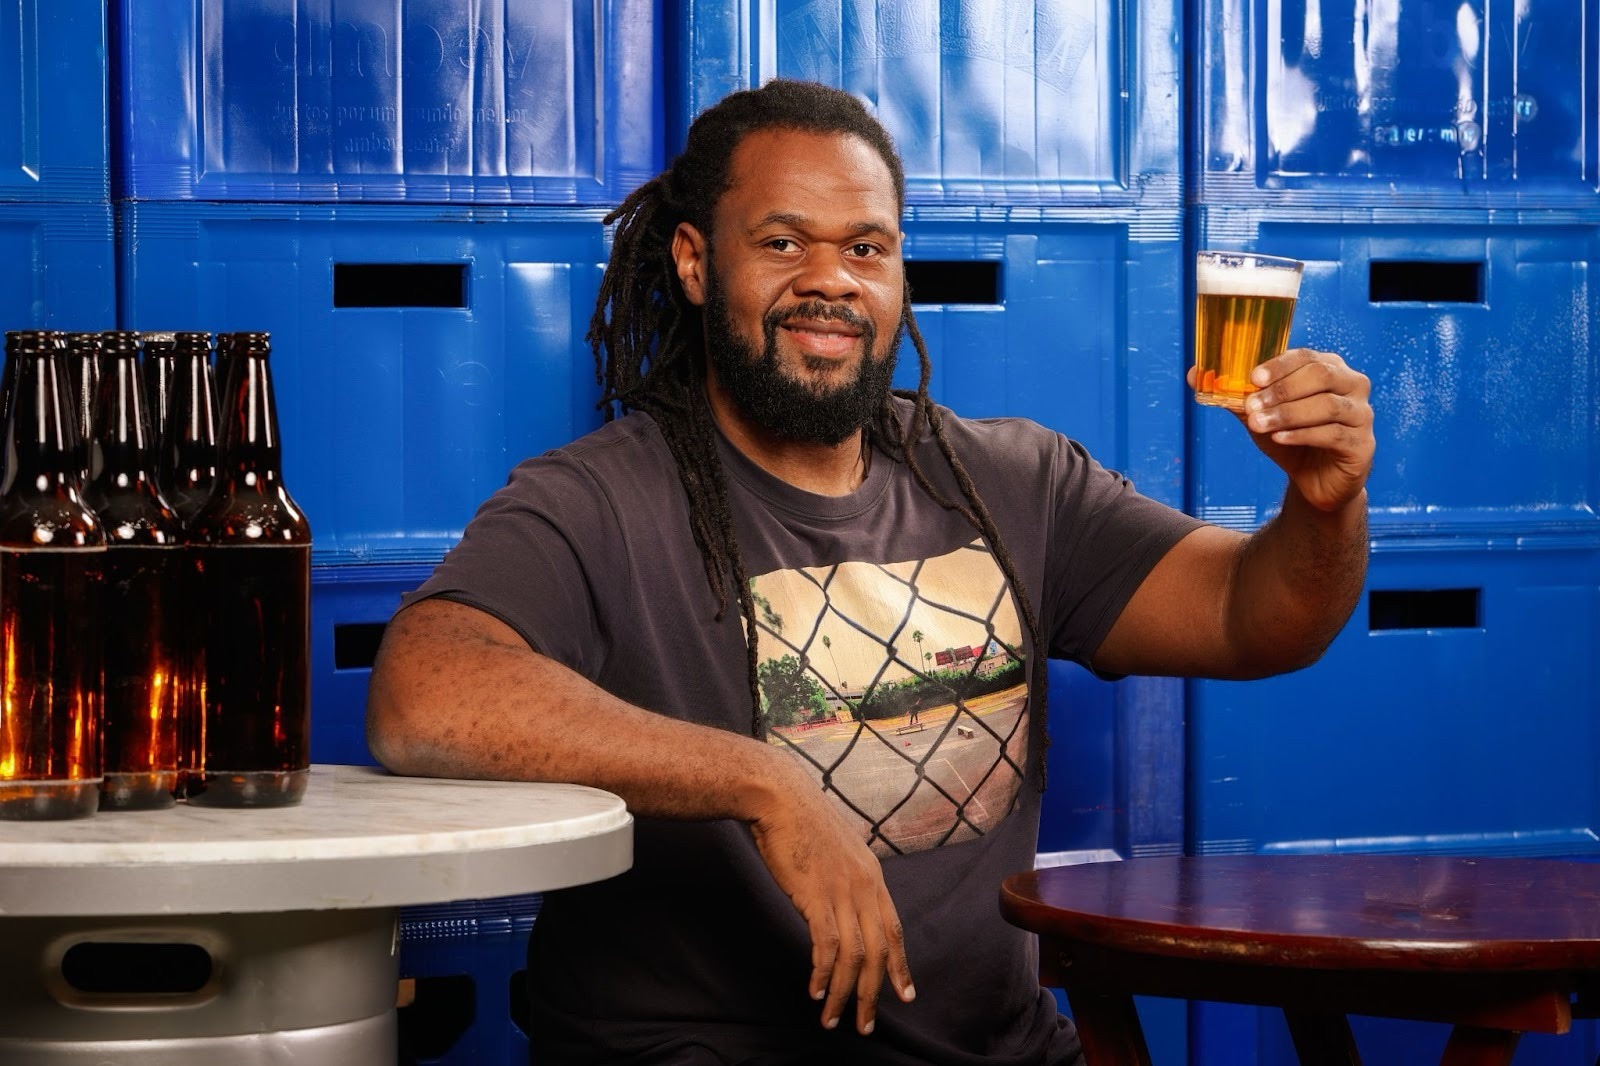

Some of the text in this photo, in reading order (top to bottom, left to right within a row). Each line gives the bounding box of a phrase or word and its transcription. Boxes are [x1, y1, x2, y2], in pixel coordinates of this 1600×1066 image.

[338, 105, 365, 126] por
[370, 106, 396, 121] um
[405, 103, 462, 122] undo
